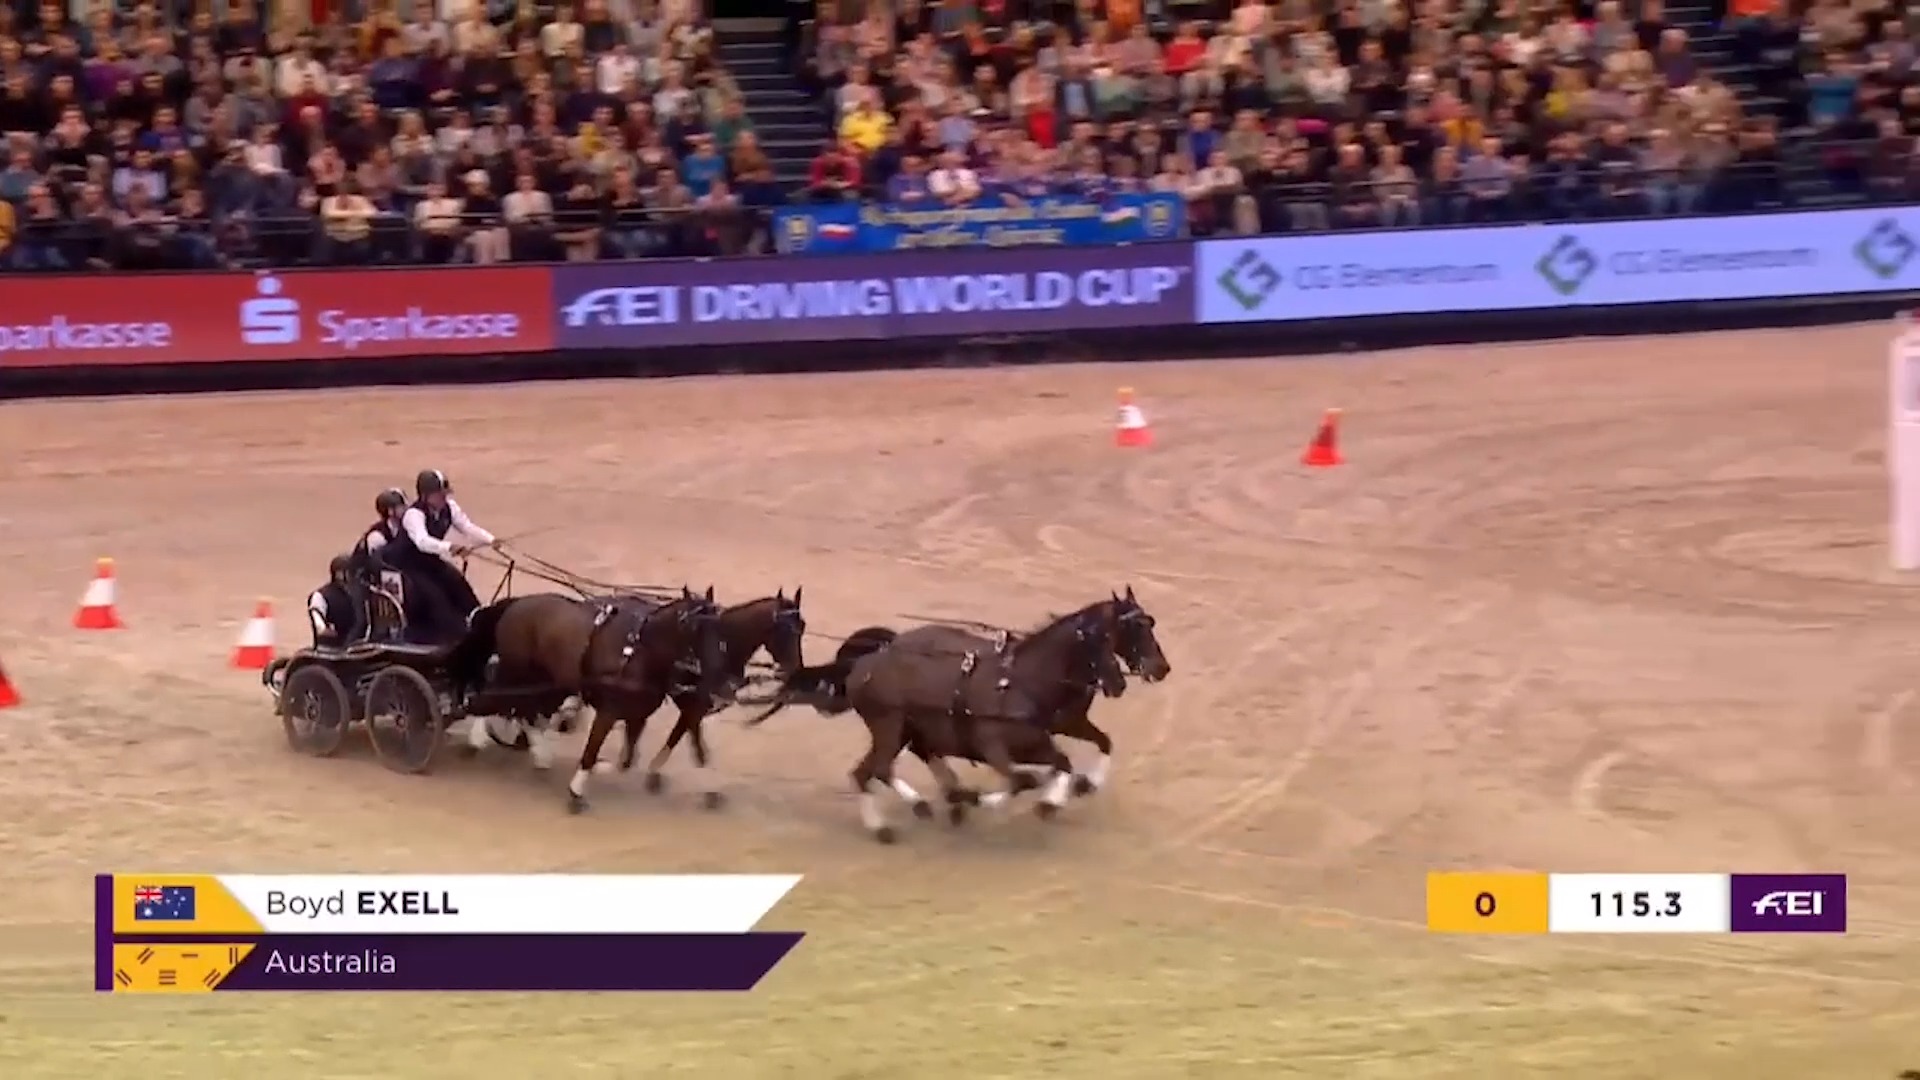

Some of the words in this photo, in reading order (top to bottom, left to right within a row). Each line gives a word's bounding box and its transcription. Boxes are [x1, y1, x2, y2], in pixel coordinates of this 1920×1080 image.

[693, 278, 891, 323] DRIVING
[896, 268, 1071, 314] WORLD
[1076, 265, 1179, 306] CUP
[317, 308, 520, 348] Sparkasse
